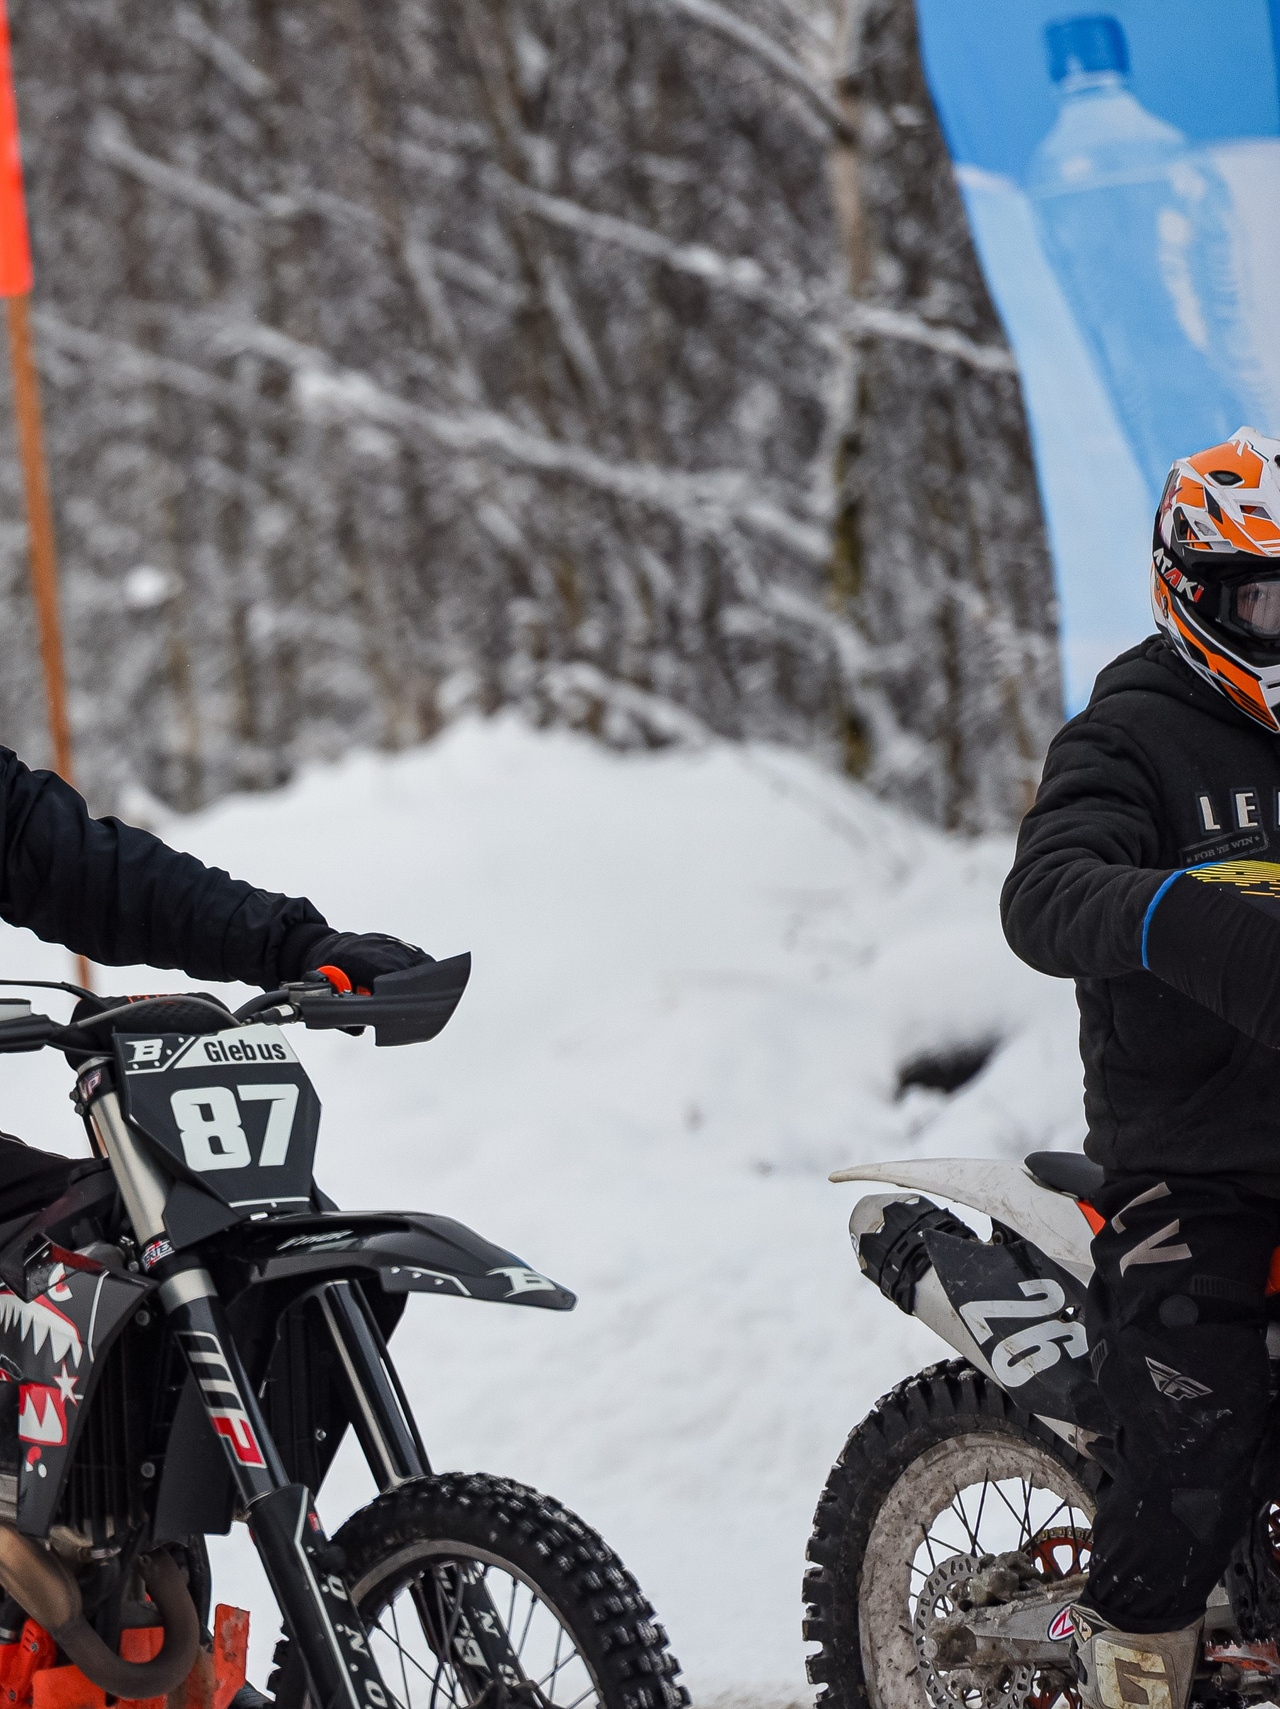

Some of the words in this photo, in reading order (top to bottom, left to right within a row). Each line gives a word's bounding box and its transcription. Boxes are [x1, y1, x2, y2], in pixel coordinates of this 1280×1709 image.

[1199, 790, 1280, 831] LE
[203, 1039, 287, 1063] Glebus
[171, 1083, 300, 1173] 87
[958, 1278, 1090, 1389] 26
